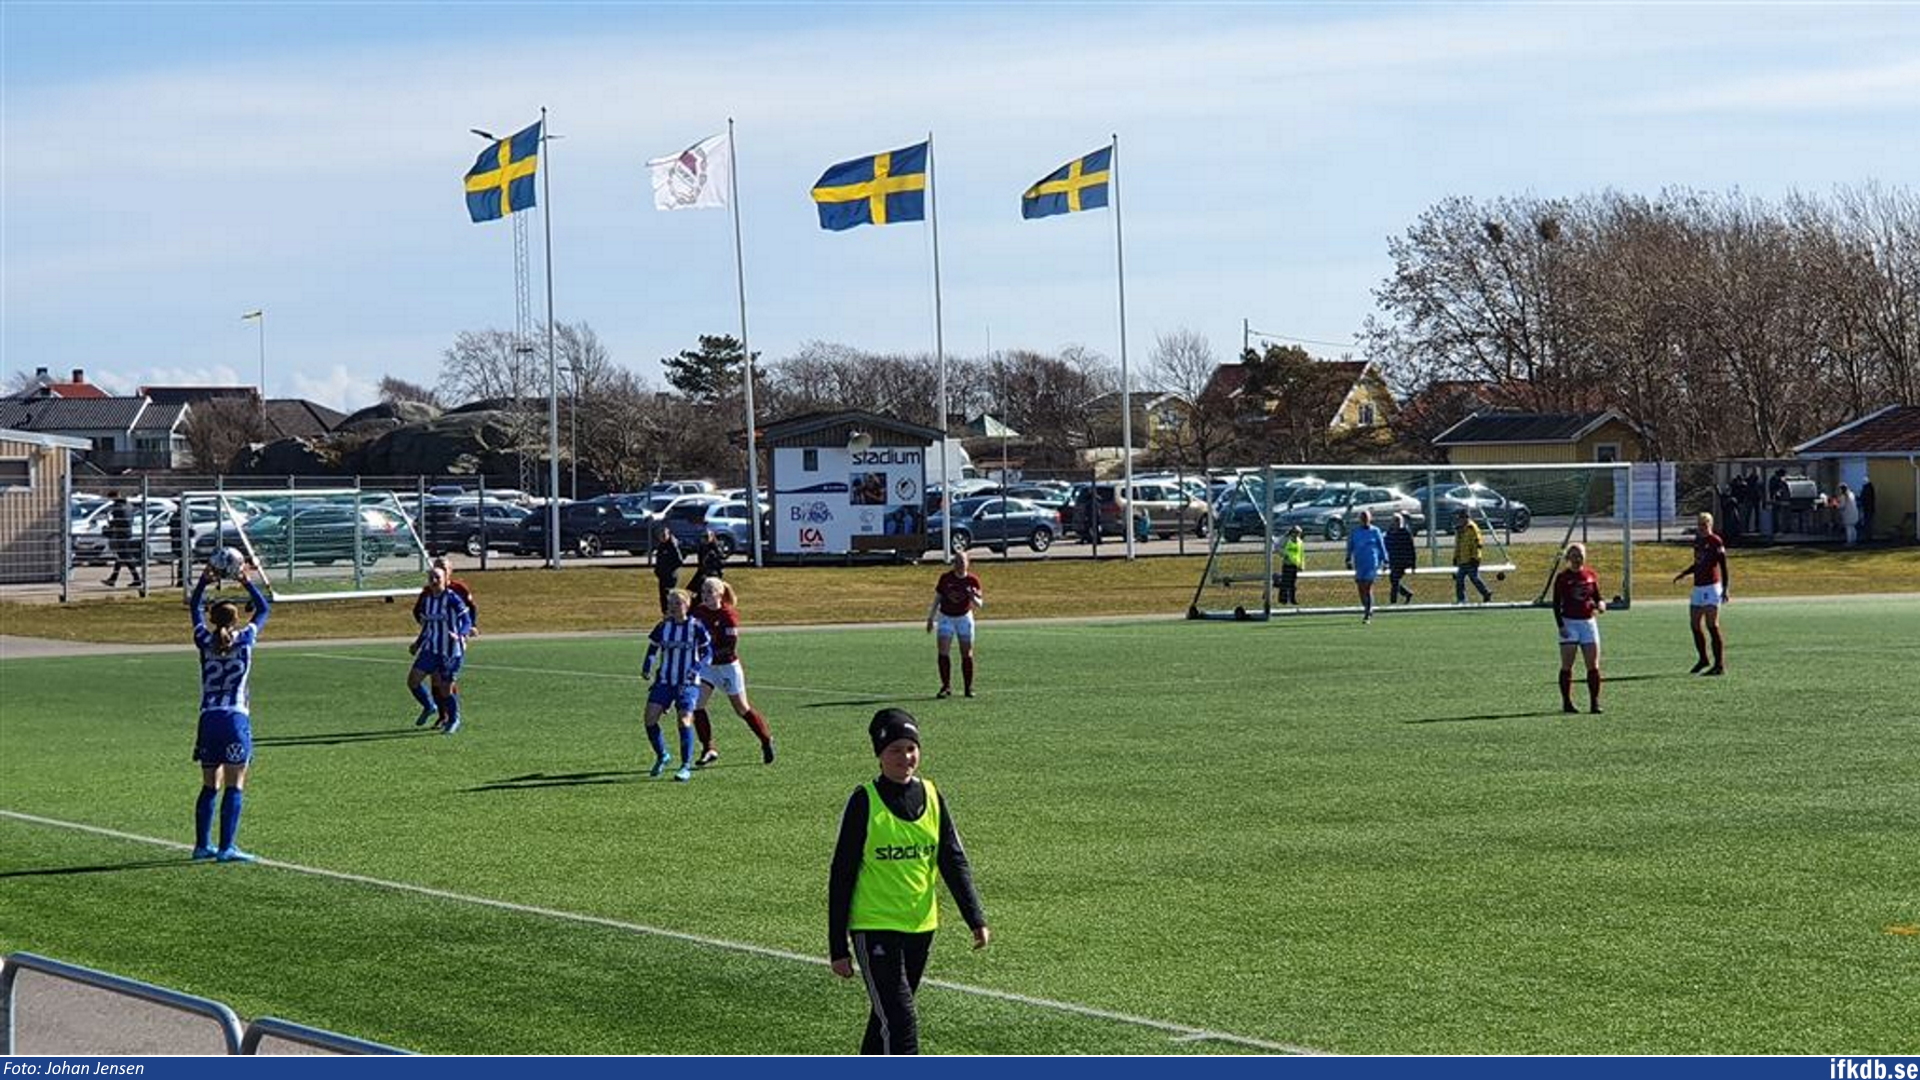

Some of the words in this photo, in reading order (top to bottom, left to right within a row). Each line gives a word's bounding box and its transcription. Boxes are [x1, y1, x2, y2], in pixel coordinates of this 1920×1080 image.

[852, 449, 920, 465] stadium
[799, 528, 824, 543] ICA
[204, 660, 245, 692] 22
